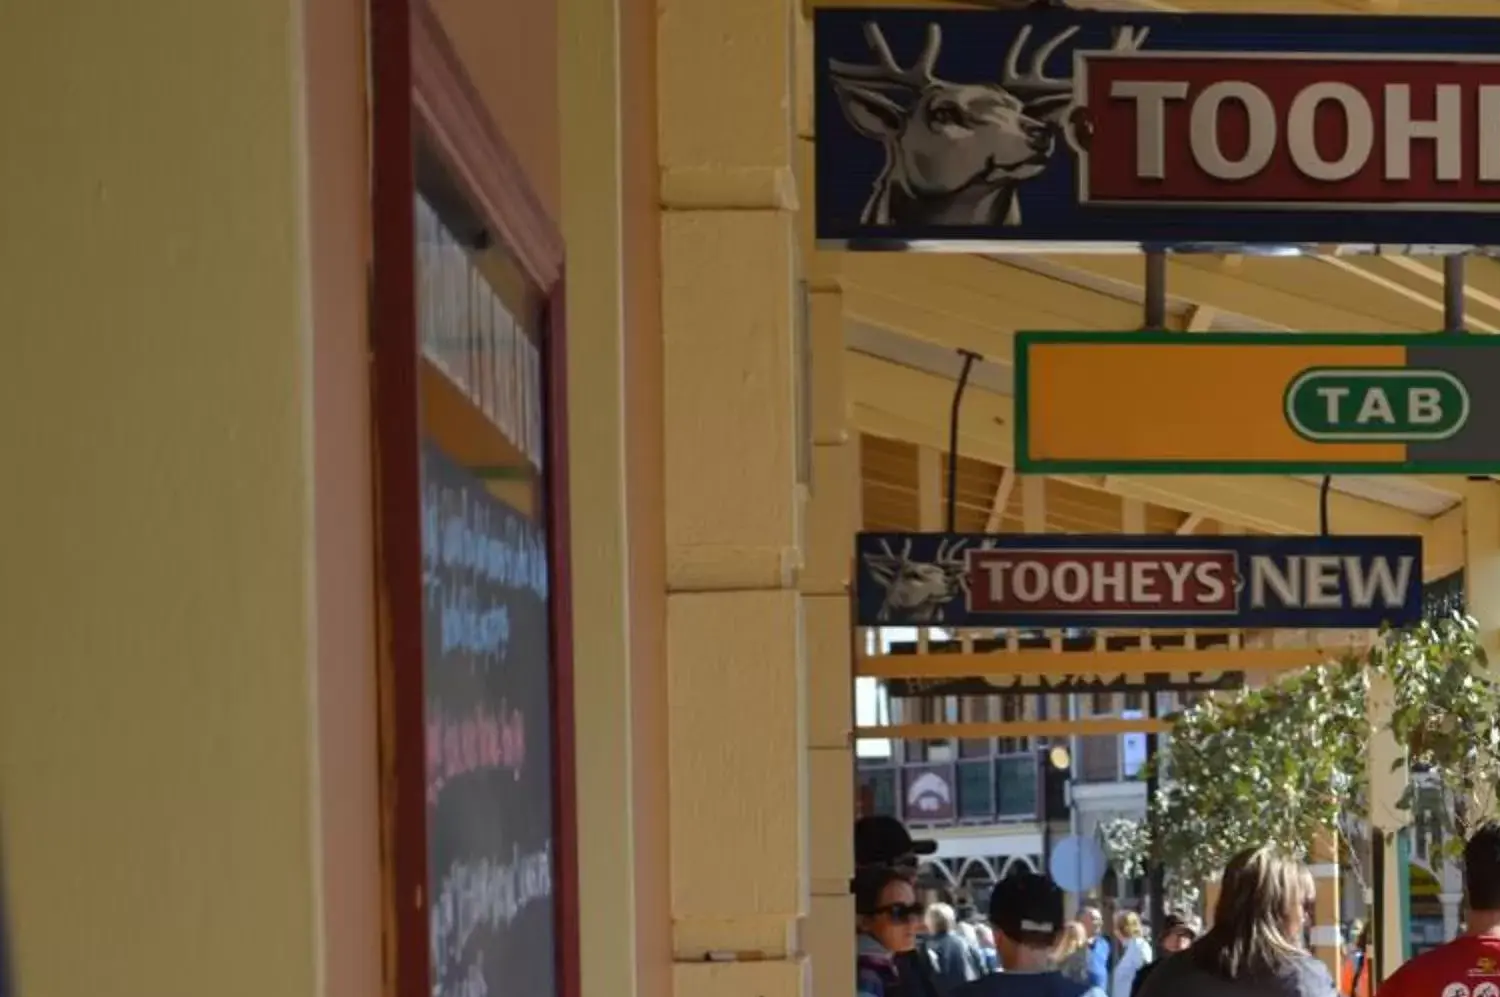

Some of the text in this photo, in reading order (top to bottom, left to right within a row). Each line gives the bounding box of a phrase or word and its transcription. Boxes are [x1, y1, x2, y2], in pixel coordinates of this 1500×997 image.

[1318, 388, 1441, 423] TAB
[979, 556, 1416, 608] TOOHEYS NEW
